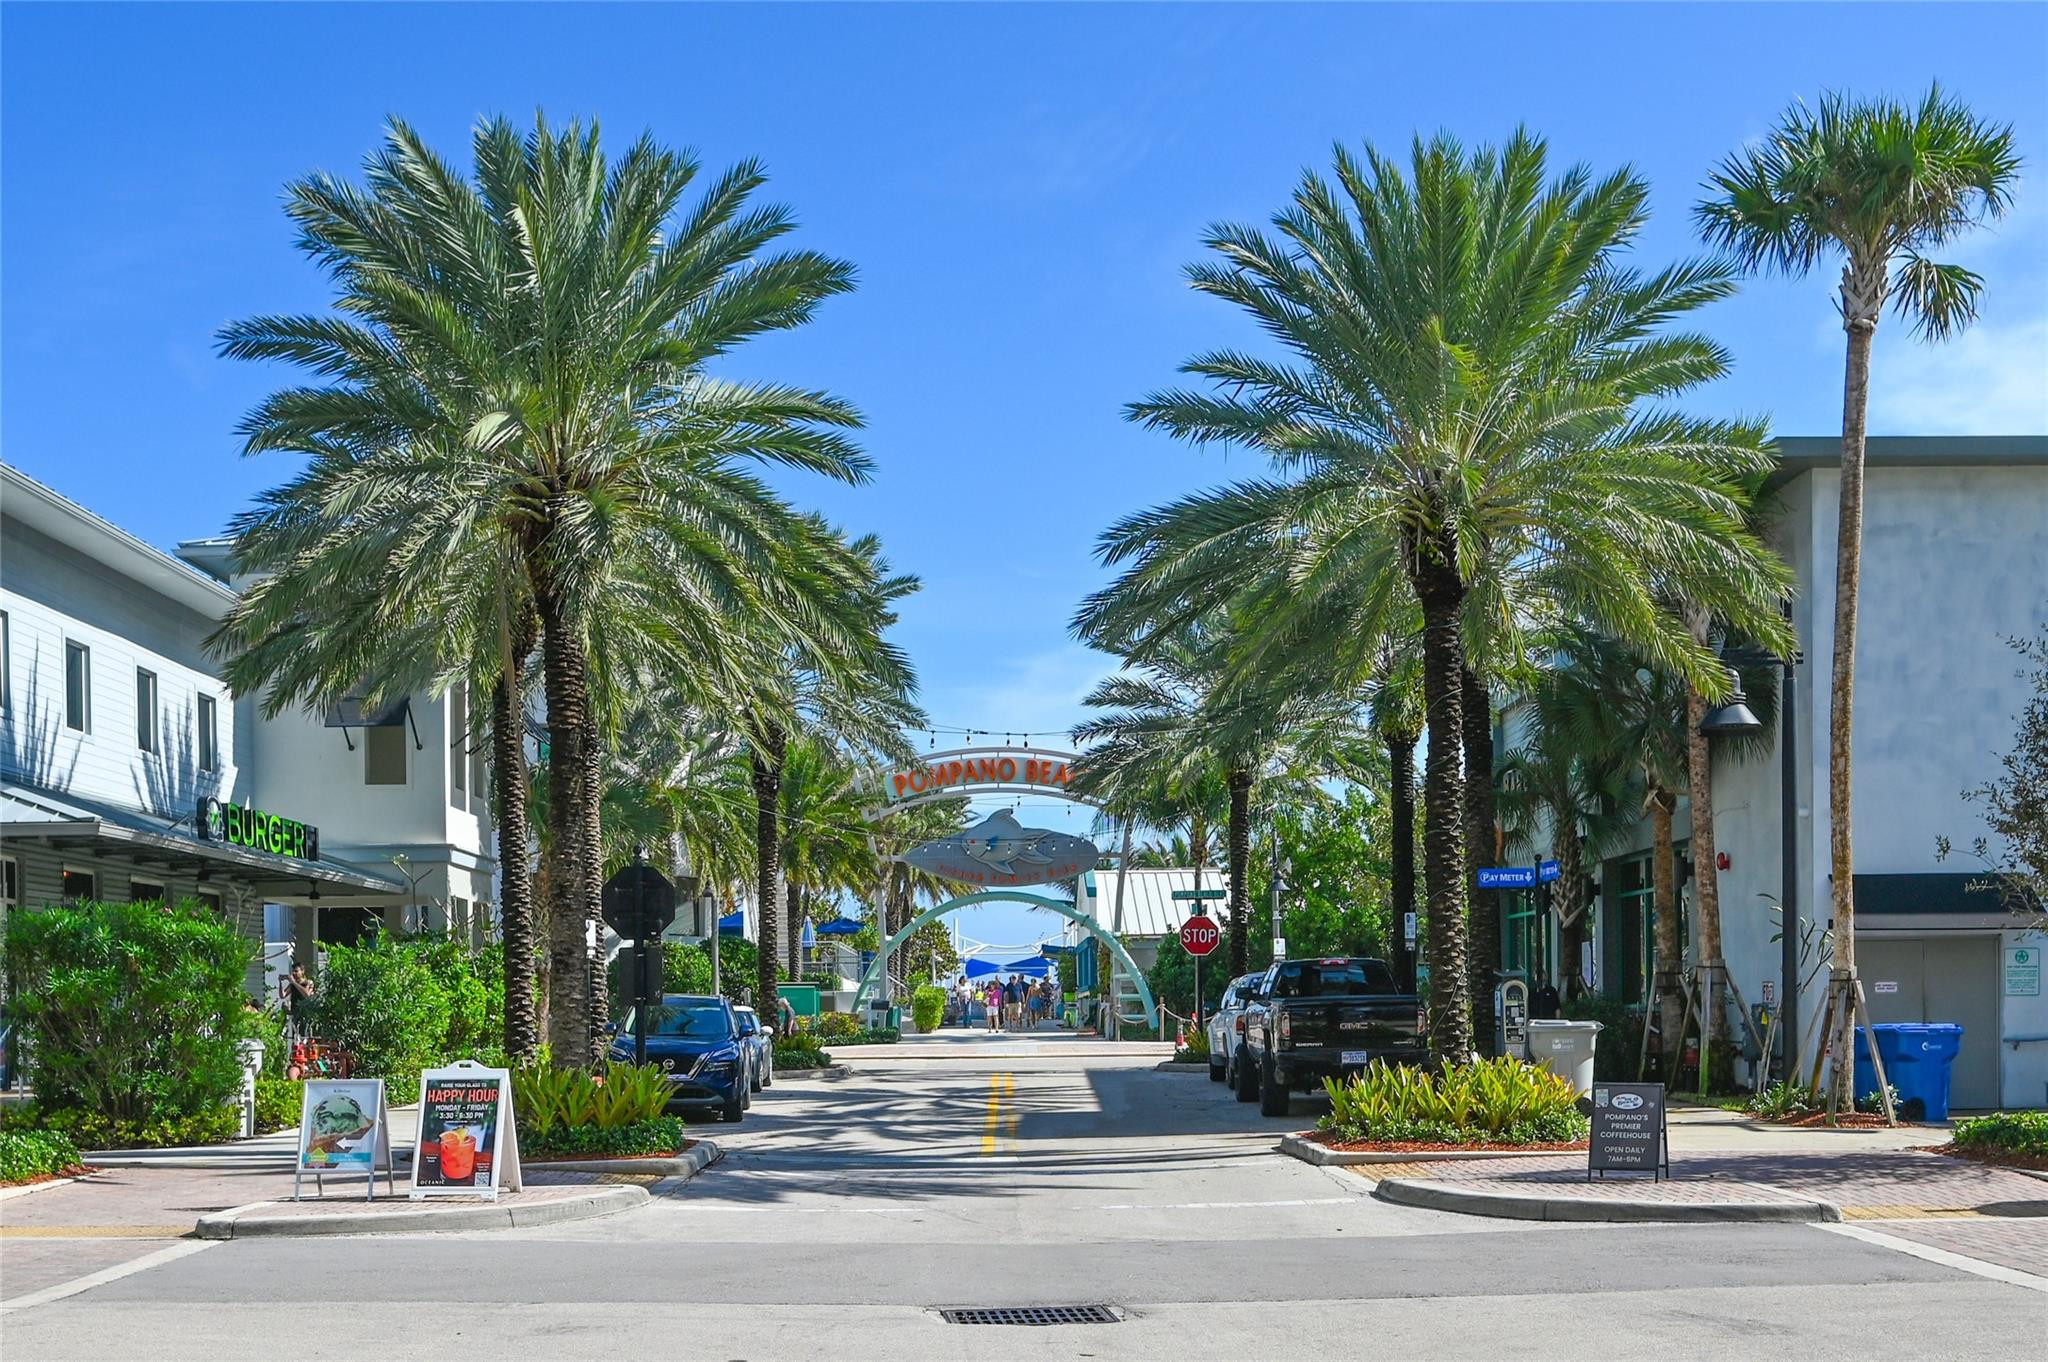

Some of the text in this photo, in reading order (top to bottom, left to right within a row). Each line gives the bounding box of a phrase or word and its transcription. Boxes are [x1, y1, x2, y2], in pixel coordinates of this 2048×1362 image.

[893, 757, 1072, 798] POMPANO BEA
[1183, 928, 1217, 943] STOP
[427, 1089, 498, 1102] HAPPY HOUR
[1611, 1122, 1641, 1130] PREMIER
[1600, 1131, 1651, 1139] COFFEEHOUSE
[1625, 1146, 1645, 1154] DAILY
